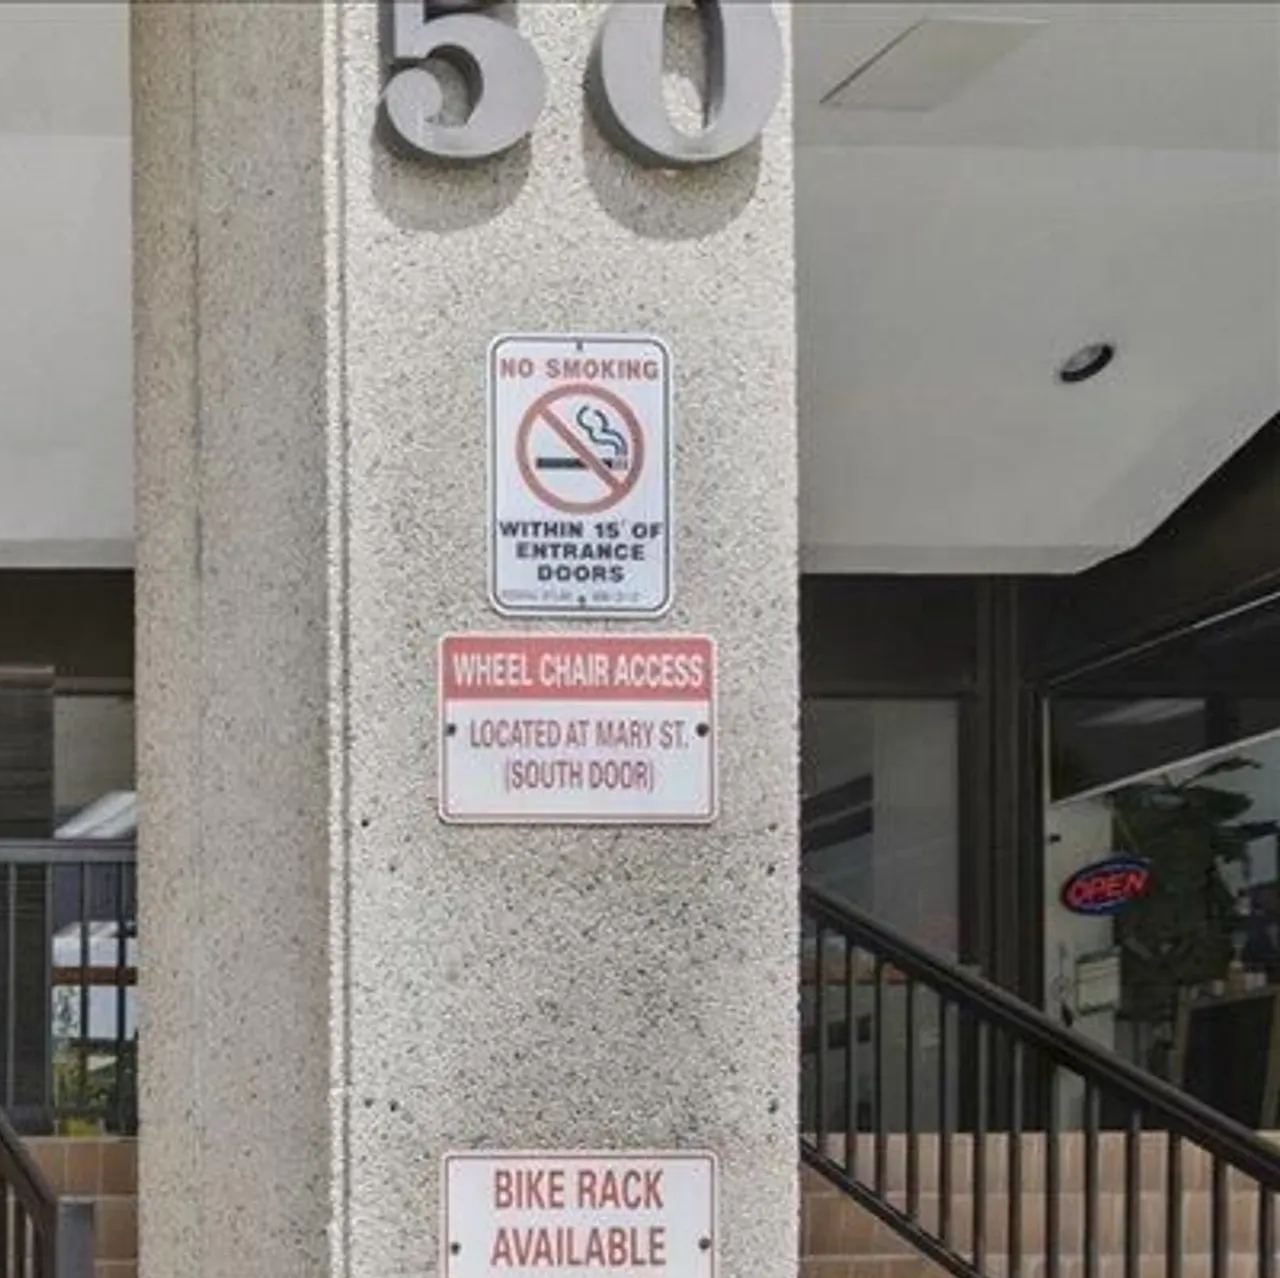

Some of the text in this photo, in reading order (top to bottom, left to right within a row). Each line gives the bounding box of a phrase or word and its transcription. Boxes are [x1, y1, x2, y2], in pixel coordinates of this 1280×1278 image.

[500, 358, 659, 380] NO SMOKING
[500, 521, 584, 538] WITHIN
[631, 522, 664, 539] OF
[516, 542, 646, 561] ENTRANCE
[537, 564, 624, 583] DOORS
[452, 653, 705, 688] WHEEL CHAIR ACCESS
[469, 719, 689, 748] LOCATED AT MARY ST.
[506, 760, 655, 792] (SOUTH DOOR)
[1067, 869, 1150, 906] OPEN
[494, 1169, 665, 1209] BIKE RACK
[490, 1226, 667, 1267] AVAILABLE
